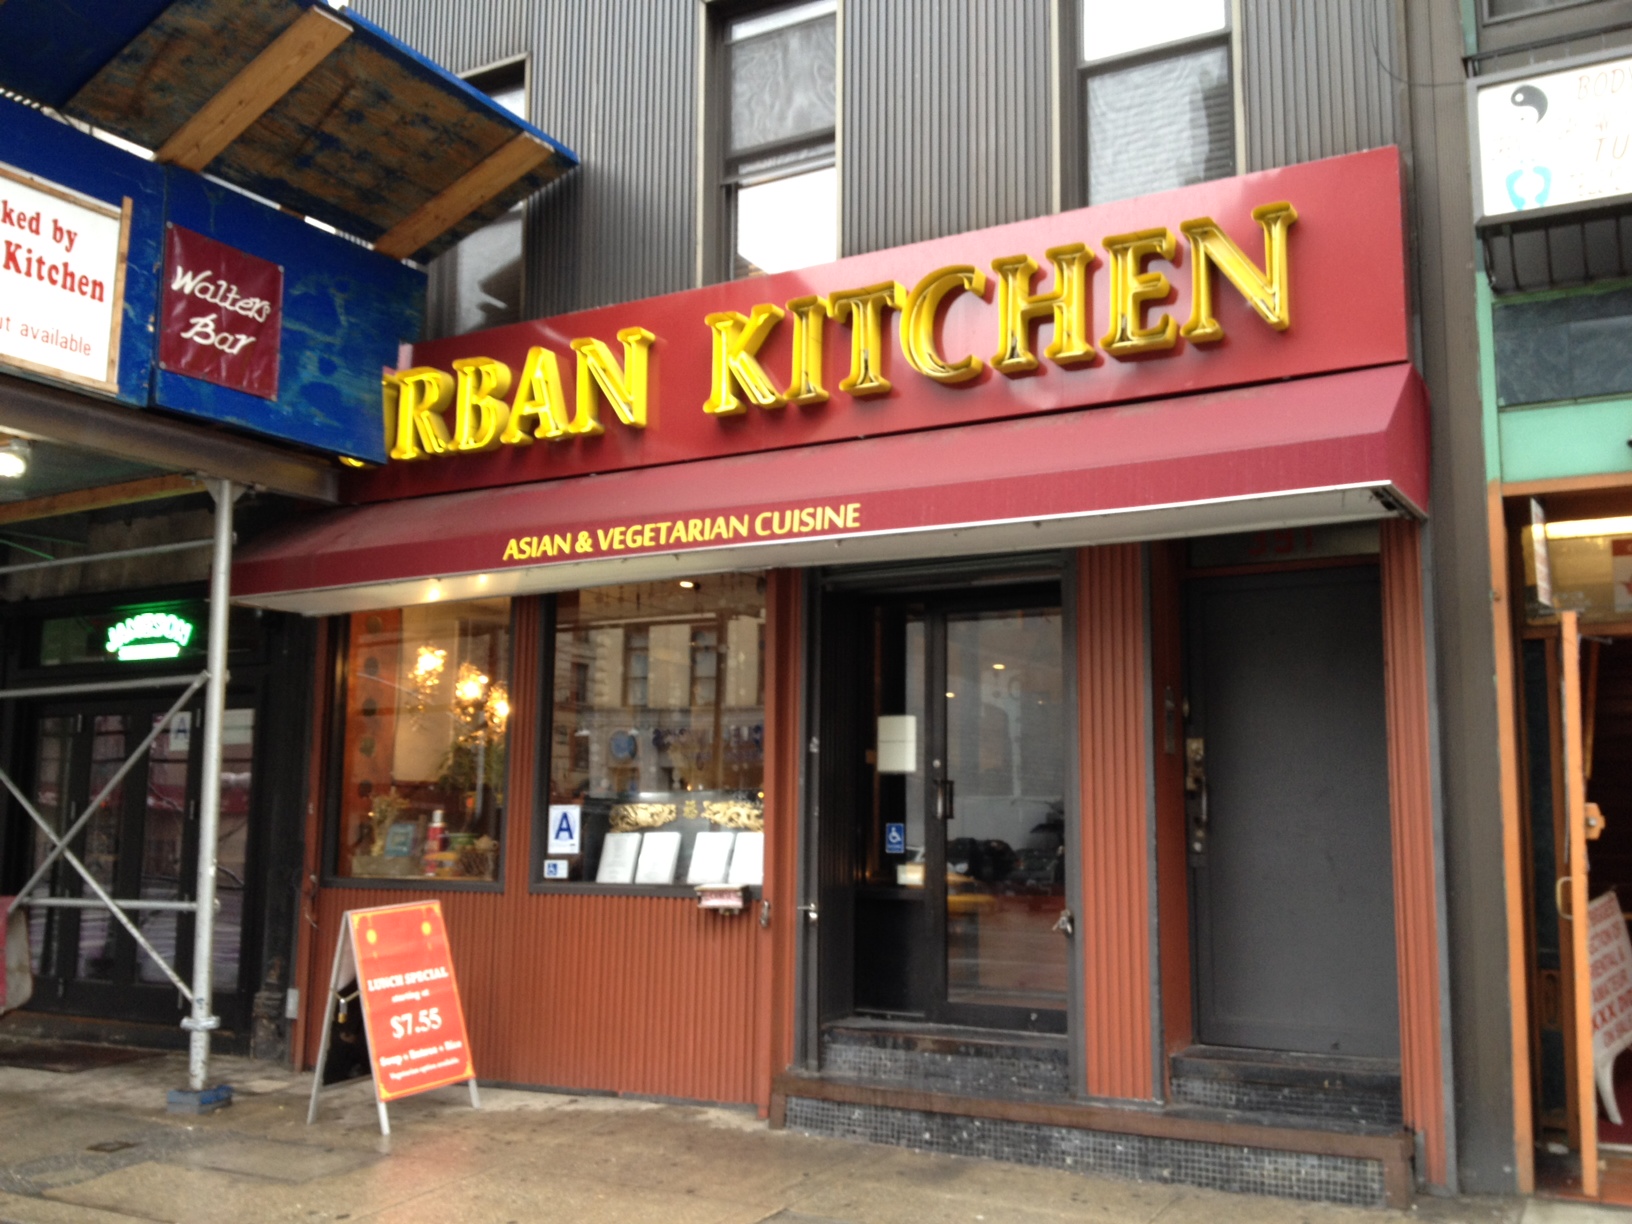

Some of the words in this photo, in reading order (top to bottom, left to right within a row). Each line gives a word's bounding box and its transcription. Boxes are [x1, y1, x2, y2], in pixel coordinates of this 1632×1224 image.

[52, 218, 78, 252] by
[3, 239, 104, 303] Kitchen
[171, 265, 271, 323] Walters
[20, 322, 91, 357] available
[180, 313, 257, 355] Bar
[345, 326, 655, 466] RBAN
[703, 201, 1297, 417] KITCHEN
[502, 532, 572, 561] ASIAN
[574, 531, 593, 553] &
[596, 513, 749, 551] VEGETARIAN
[754, 502, 861, 537] CUISINE
[554, 811, 574, 840] A
[366, 974, 404, 992] LUNCH
[404, 966, 449, 985] SPECIAL
[390, 1007, 442, 1039] $7.55
